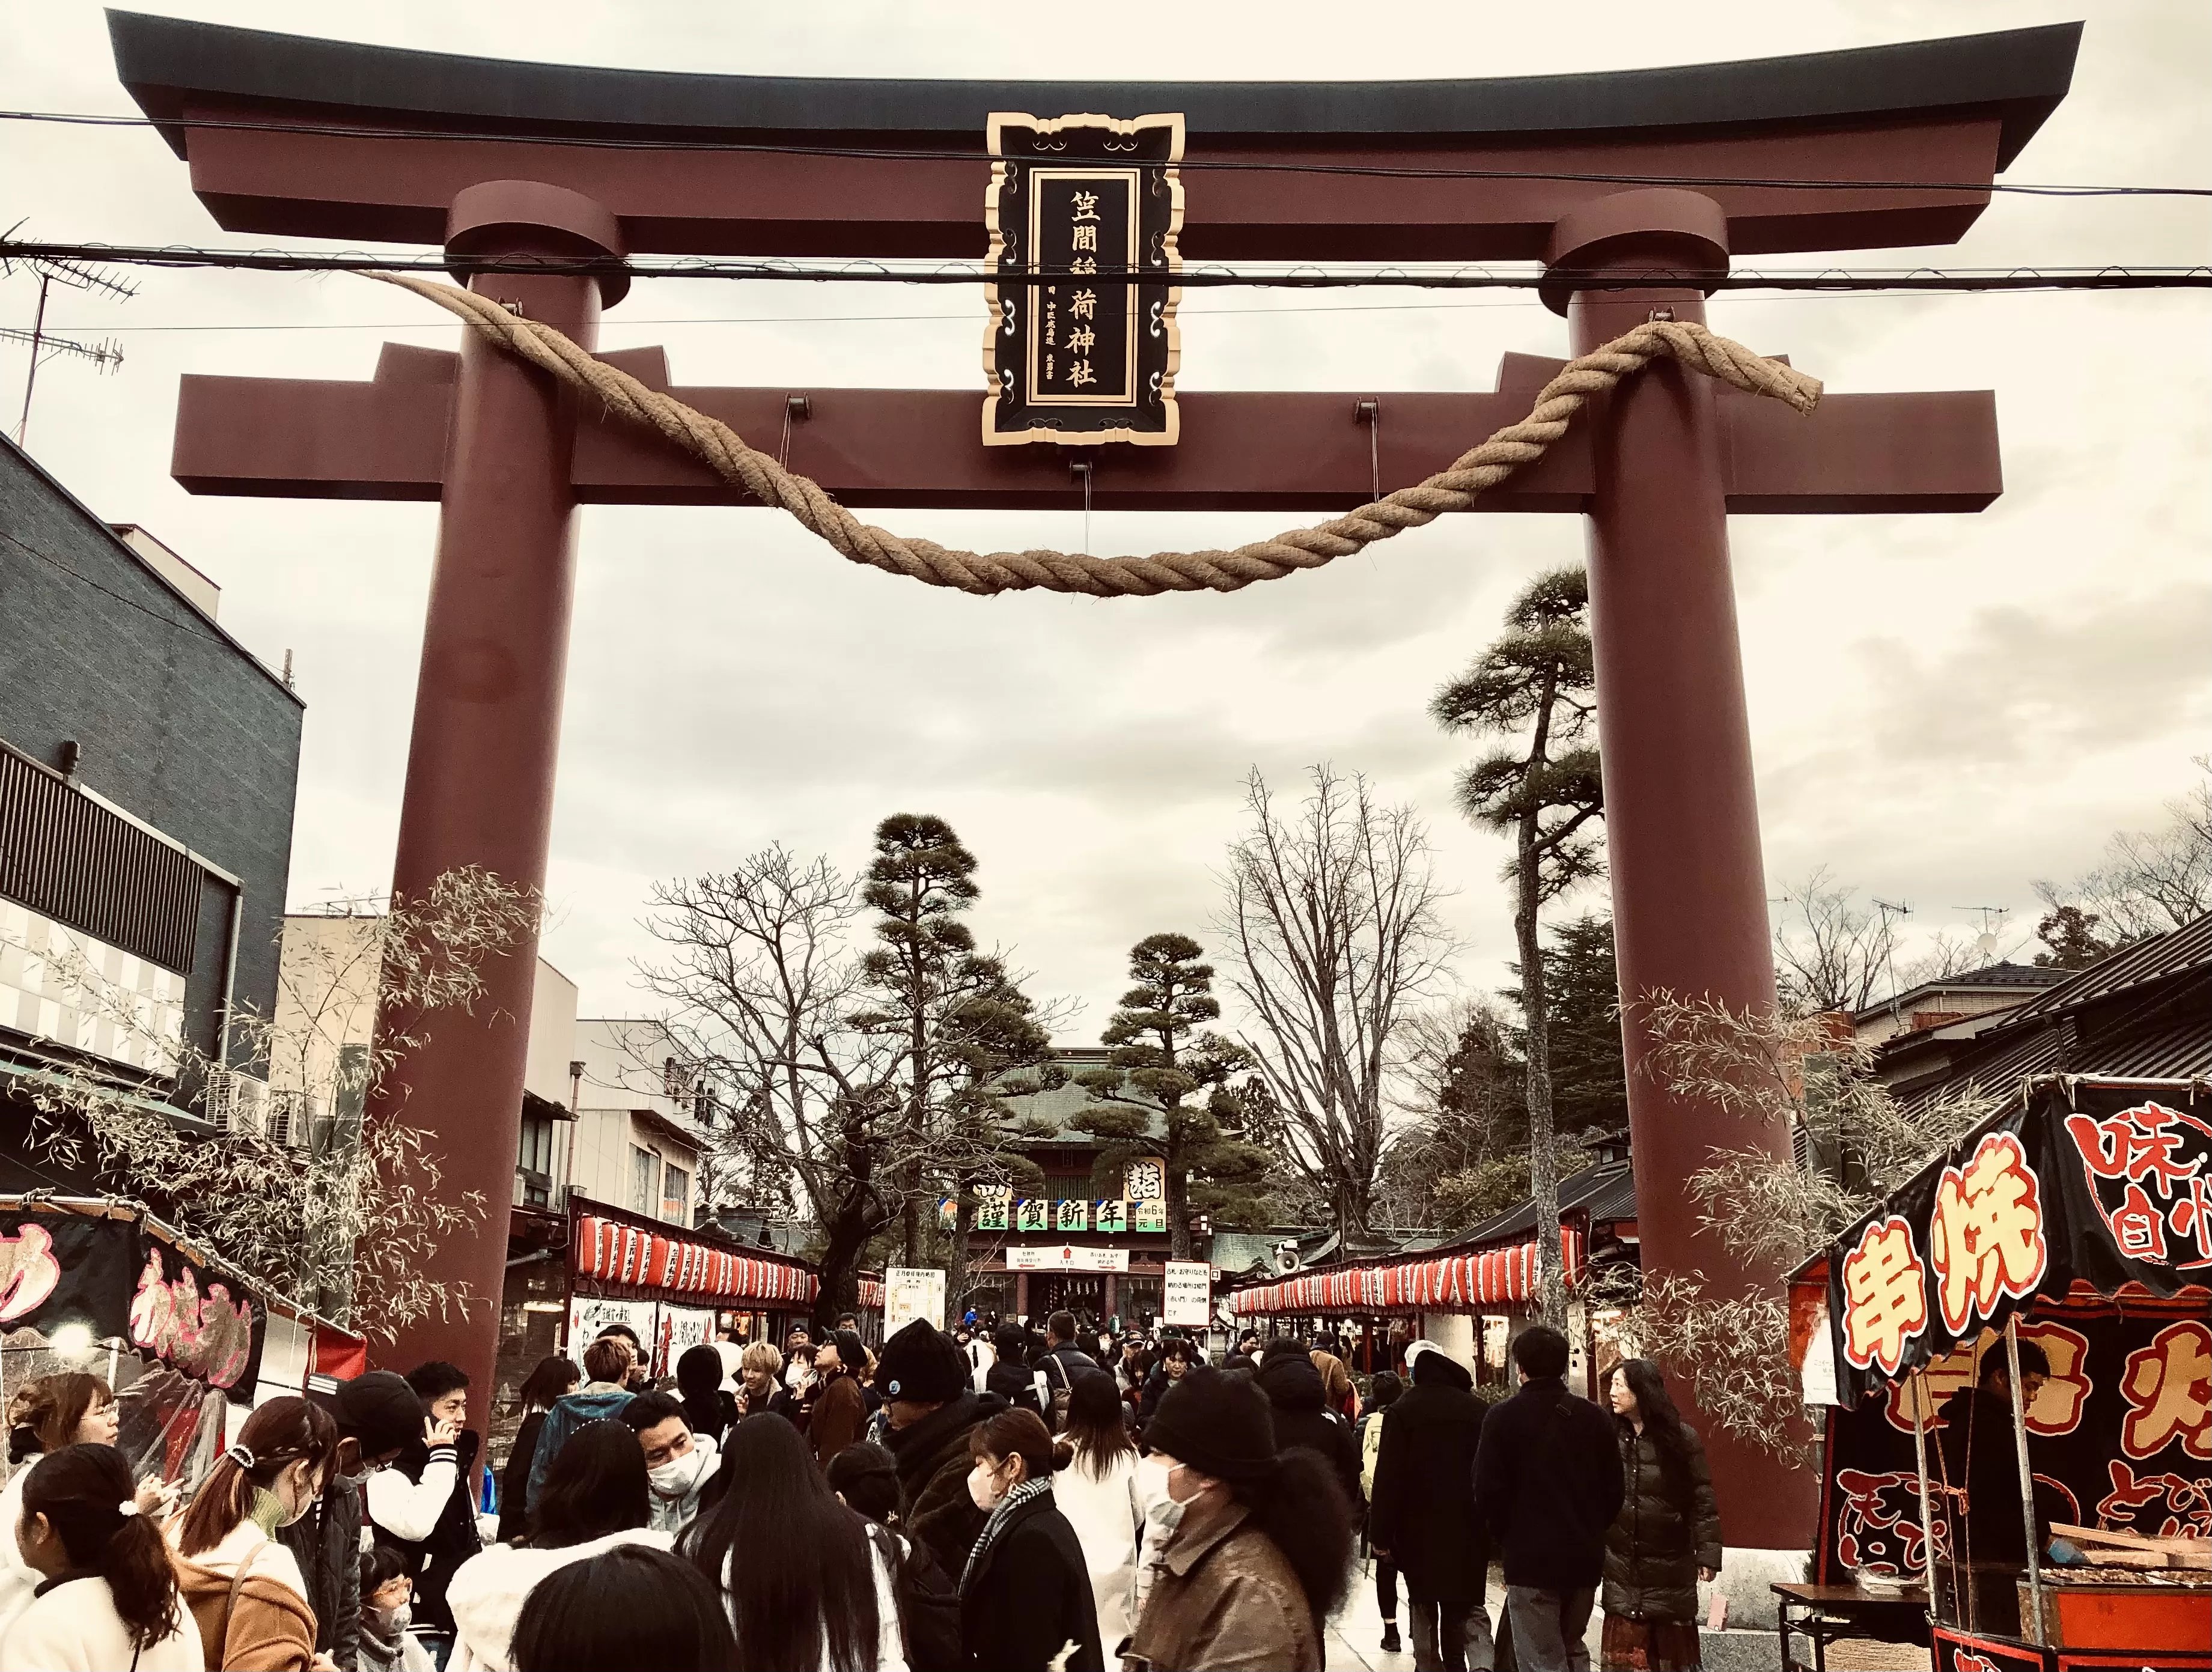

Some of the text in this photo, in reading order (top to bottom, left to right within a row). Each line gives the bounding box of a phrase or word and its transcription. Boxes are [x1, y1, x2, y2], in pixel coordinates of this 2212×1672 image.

[981, 1200, 1124, 1229] 謹賀新年
[1138, 1205, 1165, 1215] 令和6年
[1138, 1218, 1165, 1229] 元旦
[1842, 1132, 2046, 1376] 串焼
